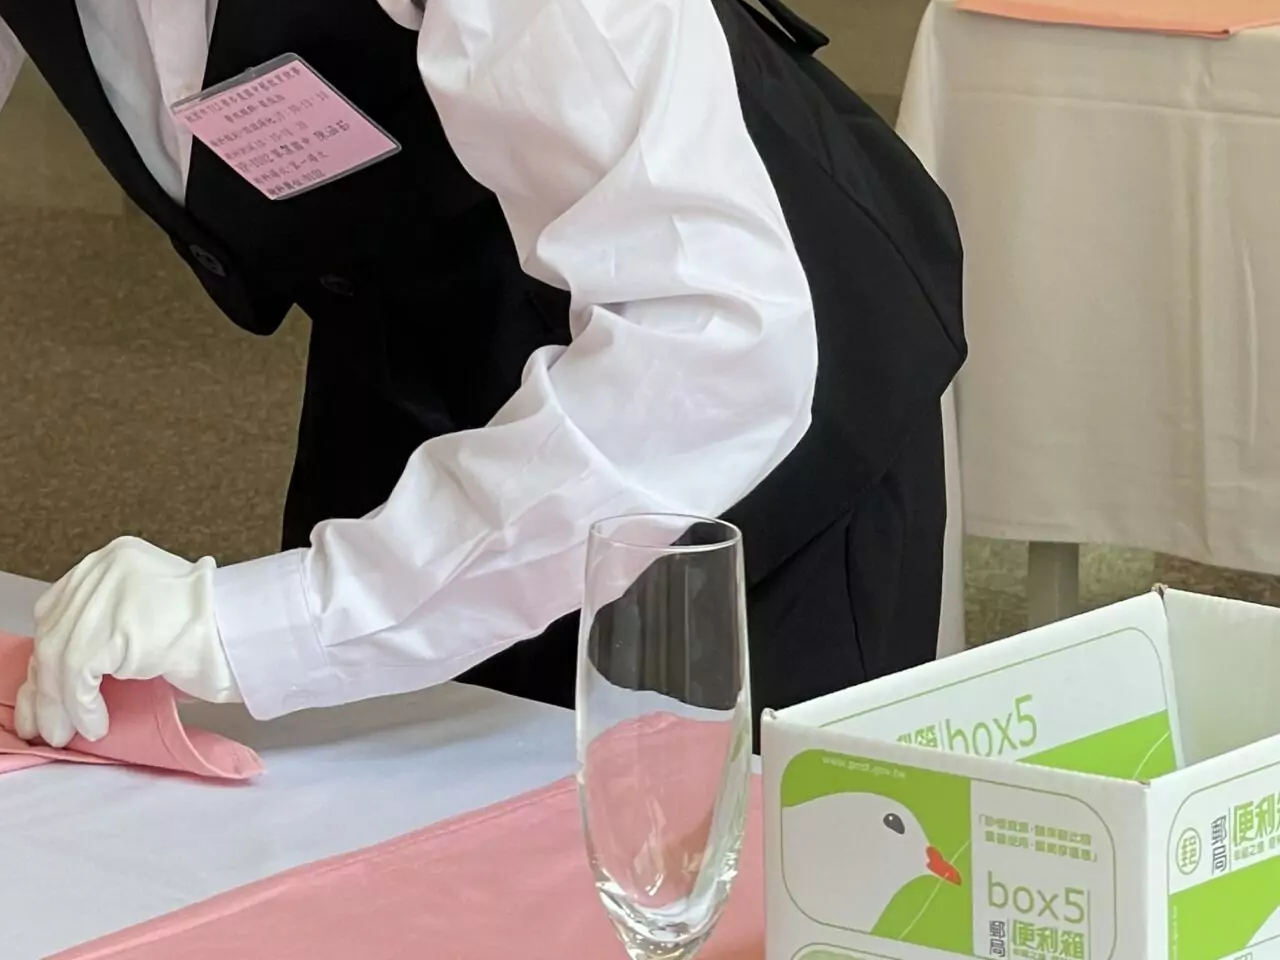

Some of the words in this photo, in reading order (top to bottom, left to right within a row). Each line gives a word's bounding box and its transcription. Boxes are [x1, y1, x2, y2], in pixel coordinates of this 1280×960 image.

[945, 693, 1038, 758] box5
[1232, 792, 1280, 847] 便利
[987, 870, 1085, 924] box5
[1012, 920, 1085, 959] 便利箱
